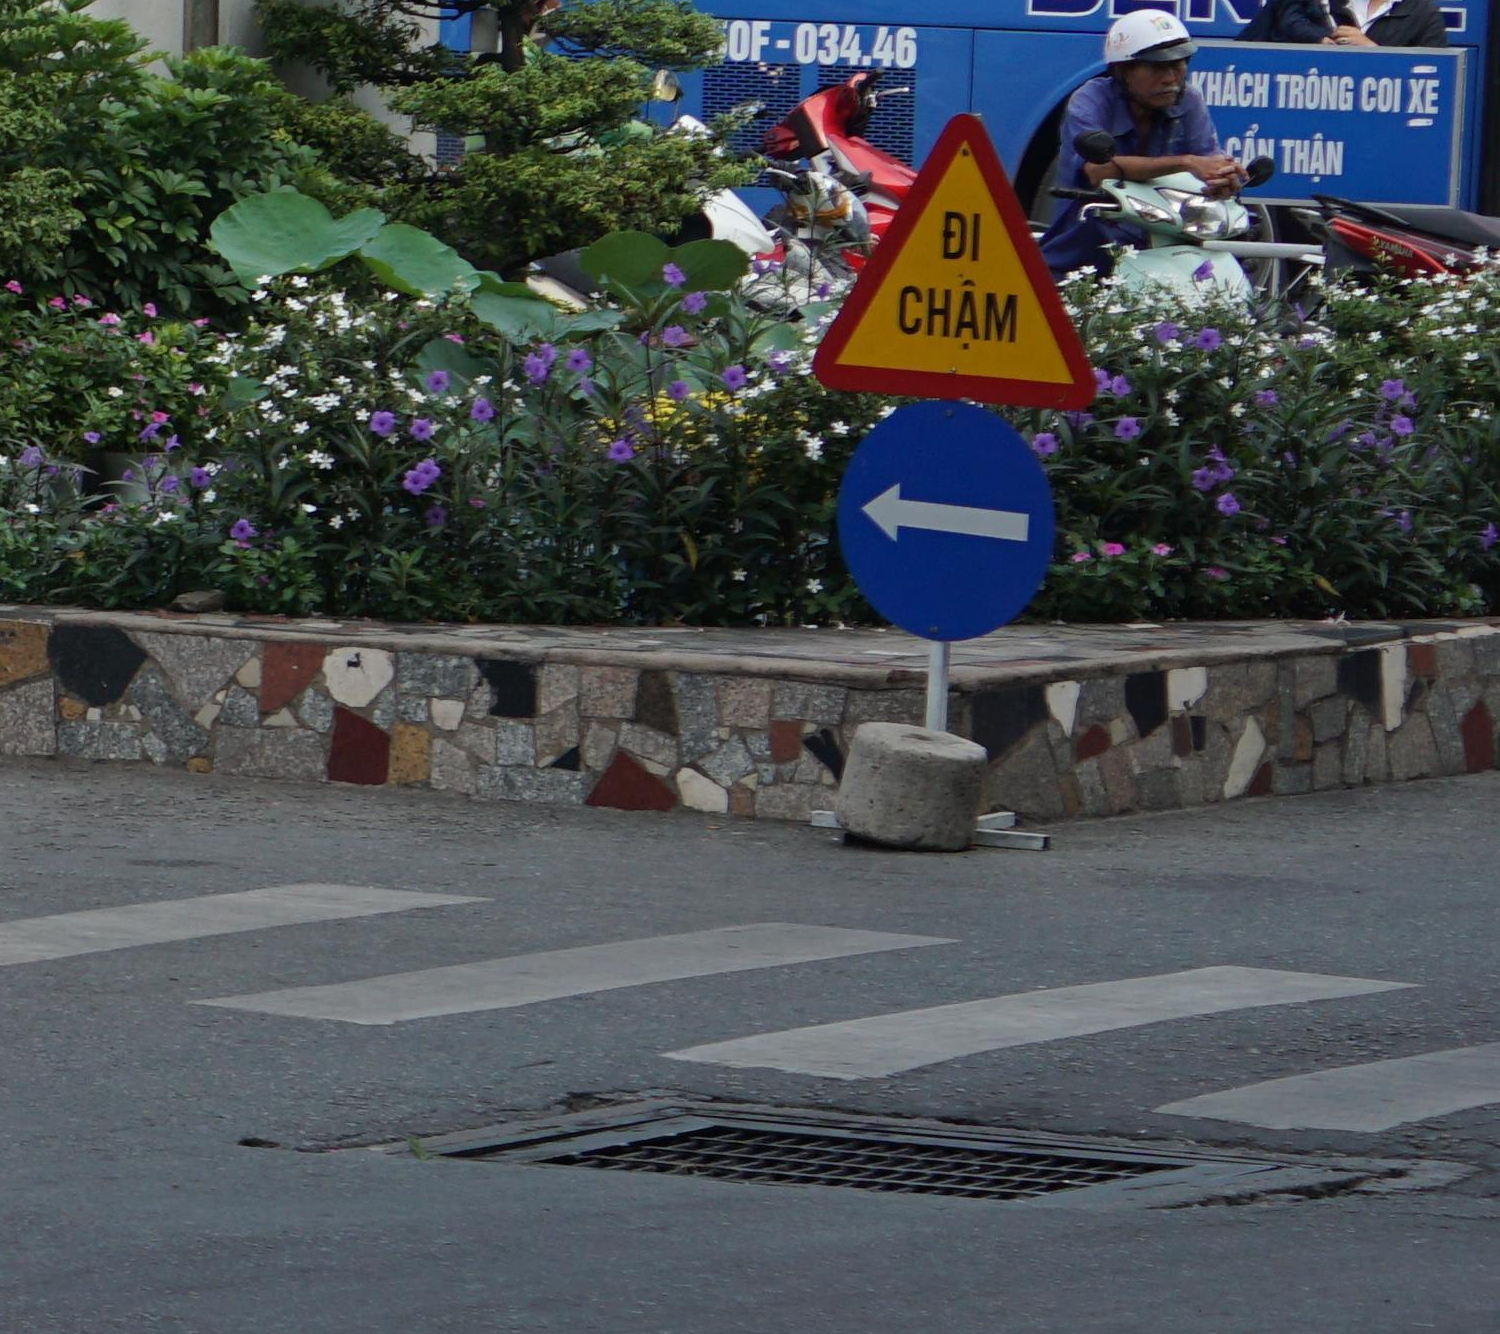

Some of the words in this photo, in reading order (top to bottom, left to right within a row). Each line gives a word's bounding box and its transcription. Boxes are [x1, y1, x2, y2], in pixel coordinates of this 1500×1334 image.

[722, 20, 771, 63] 0F
[796, 22, 917, 68] 034.46
[1190, 64, 1270, 110] KHÁCH
[1277, 68, 1354, 113] TRÔNG
[1361, 76, 1402, 113] COI
[1408, 77, 1440, 115] XE
[1281, 132, 1344, 183] THẬN
[942, 210, 981, 262] ĐI
[898, 279, 1019, 351] CHẬM
